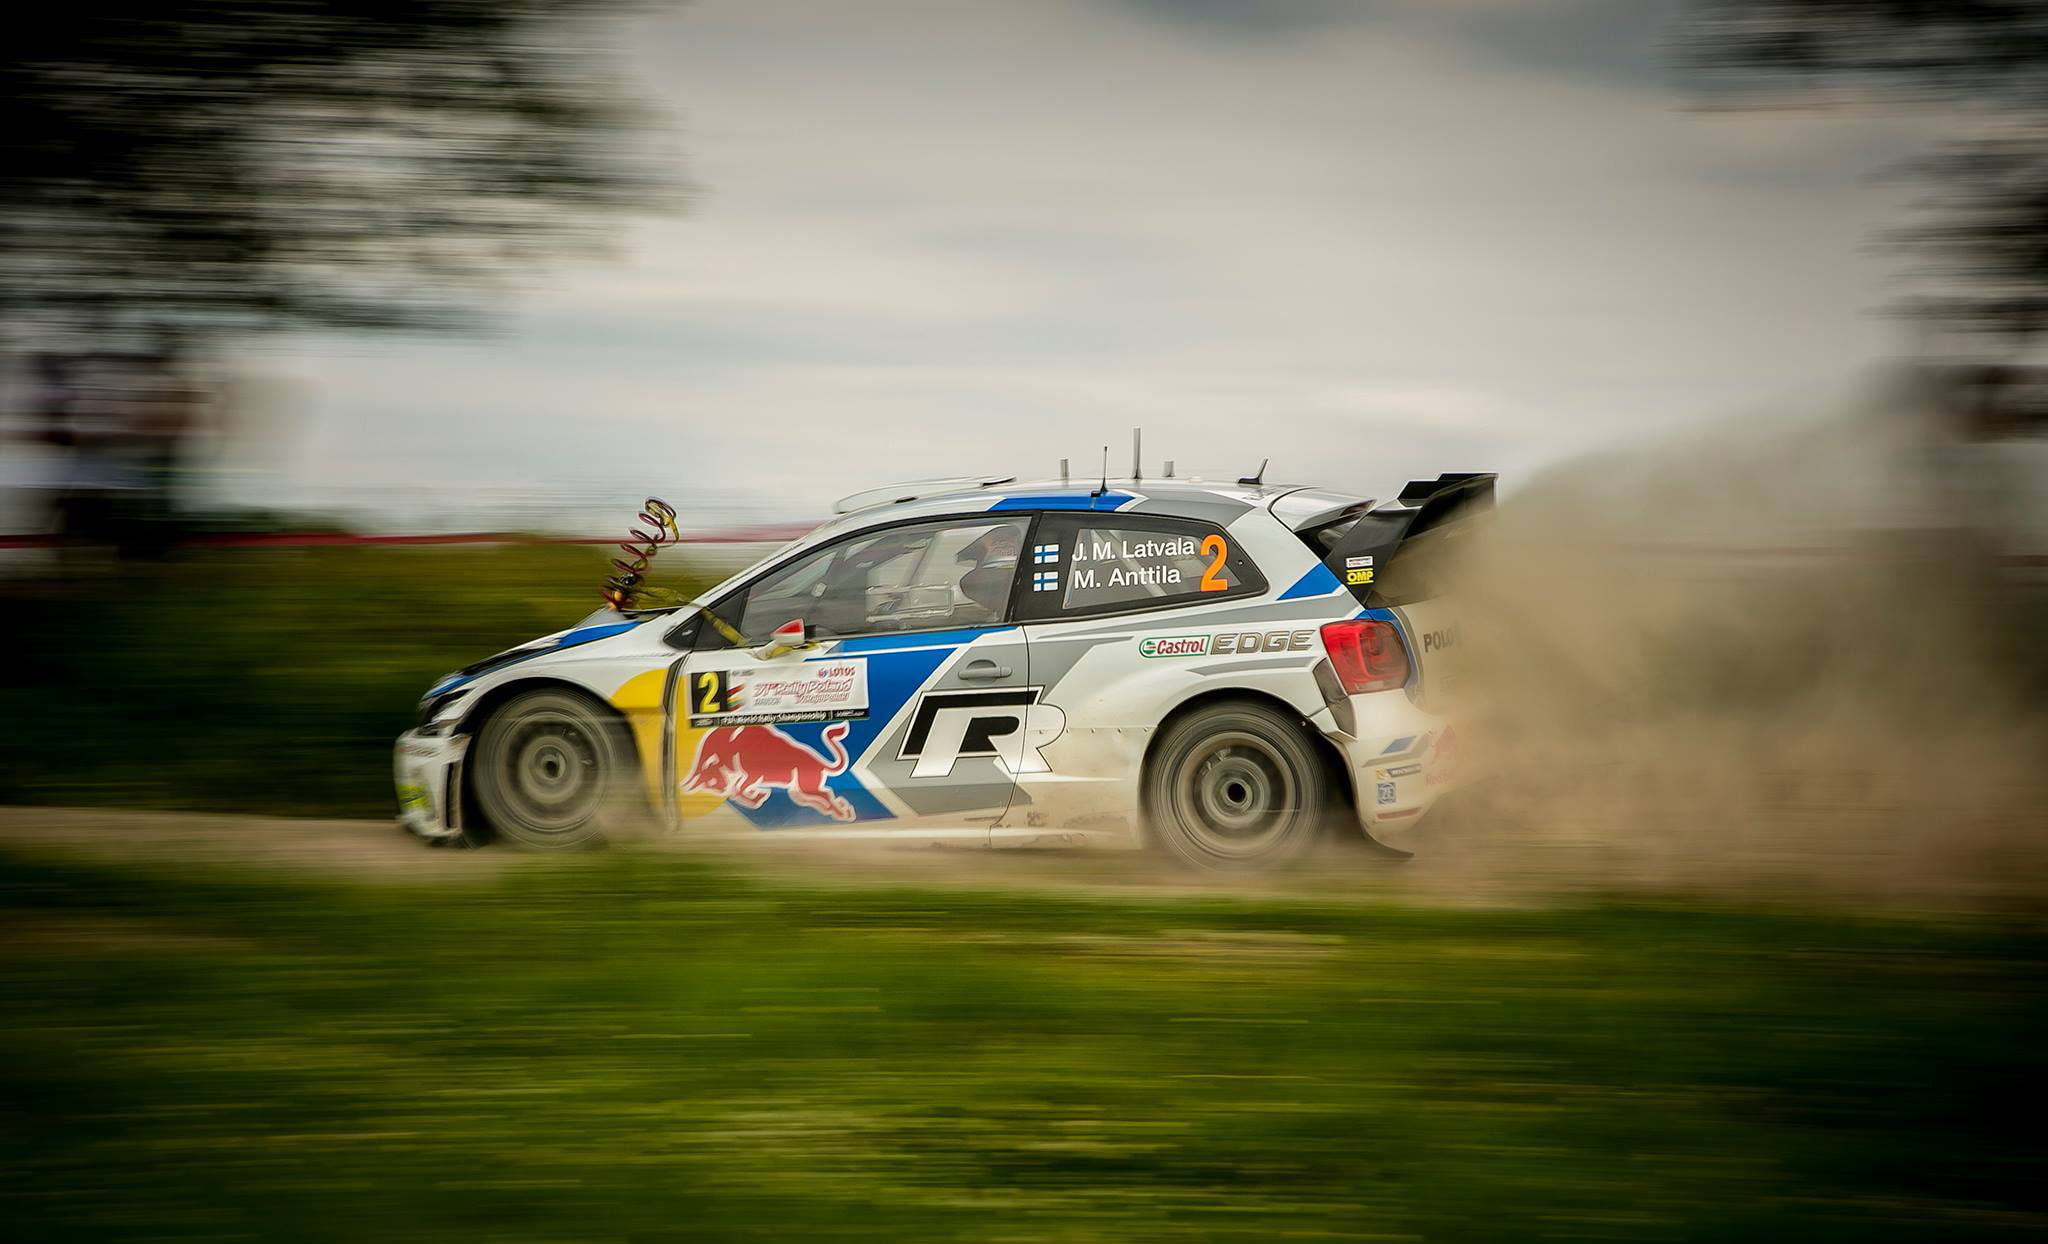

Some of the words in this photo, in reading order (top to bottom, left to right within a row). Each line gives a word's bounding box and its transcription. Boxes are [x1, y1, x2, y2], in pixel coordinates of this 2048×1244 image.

[1072, 542, 1088, 562] J.
[1092, 541, 1116, 561] M.
[1122, 537, 1195, 559] Latvala
[1200, 534, 1228, 592] 2
[1074, 569, 1101, 589] M.
[1108, 565, 1181, 587] Anttila
[1347, 570, 1374, 582] OMP
[1157, 638, 1205, 655] Castrol
[1210, 629, 1316, 655] EDGE
[1423, 628, 1454, 653] POLO
[829, 665, 856, 677] LOTOS
[698, 671, 720, 713] 2
[896, 685, 1067, 778] R
